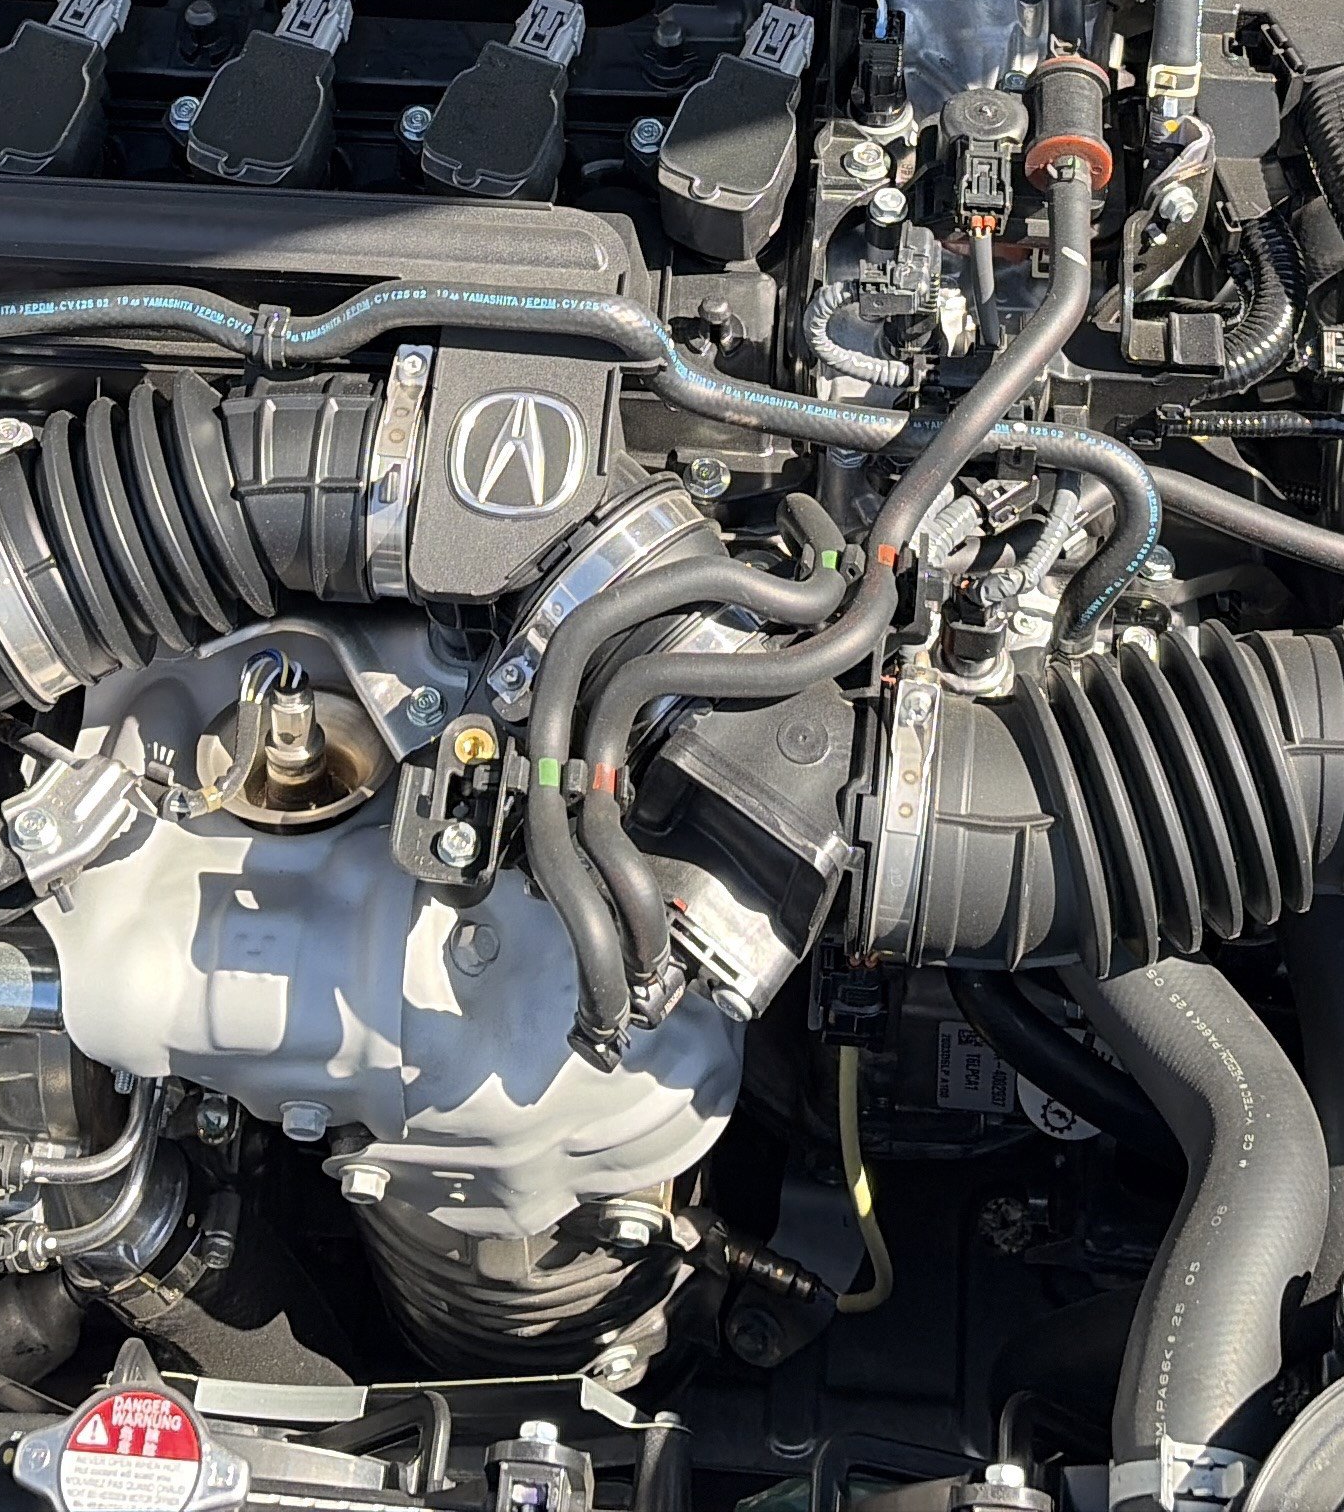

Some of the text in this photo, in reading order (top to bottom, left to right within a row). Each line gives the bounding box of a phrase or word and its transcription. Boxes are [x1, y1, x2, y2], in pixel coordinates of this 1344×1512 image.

[143, 296, 195, 312] YAMASHITA
[462, 292, 519, 307] YAMASHITA
[301, 315, 342, 342] YAMASHITA
[744, 390, 800, 411] YAMASHITA
[1169, 992, 1188, 1010] 25
[1240, 1090, 1255, 1126] Y-TEC
[1242, 1133, 1255, 1151] C2
[1170, 1301, 1185, 1327] 25
[112, 1395, 172, 1415] DANGER
[111, 1409, 183, 1432] WARNUNG
